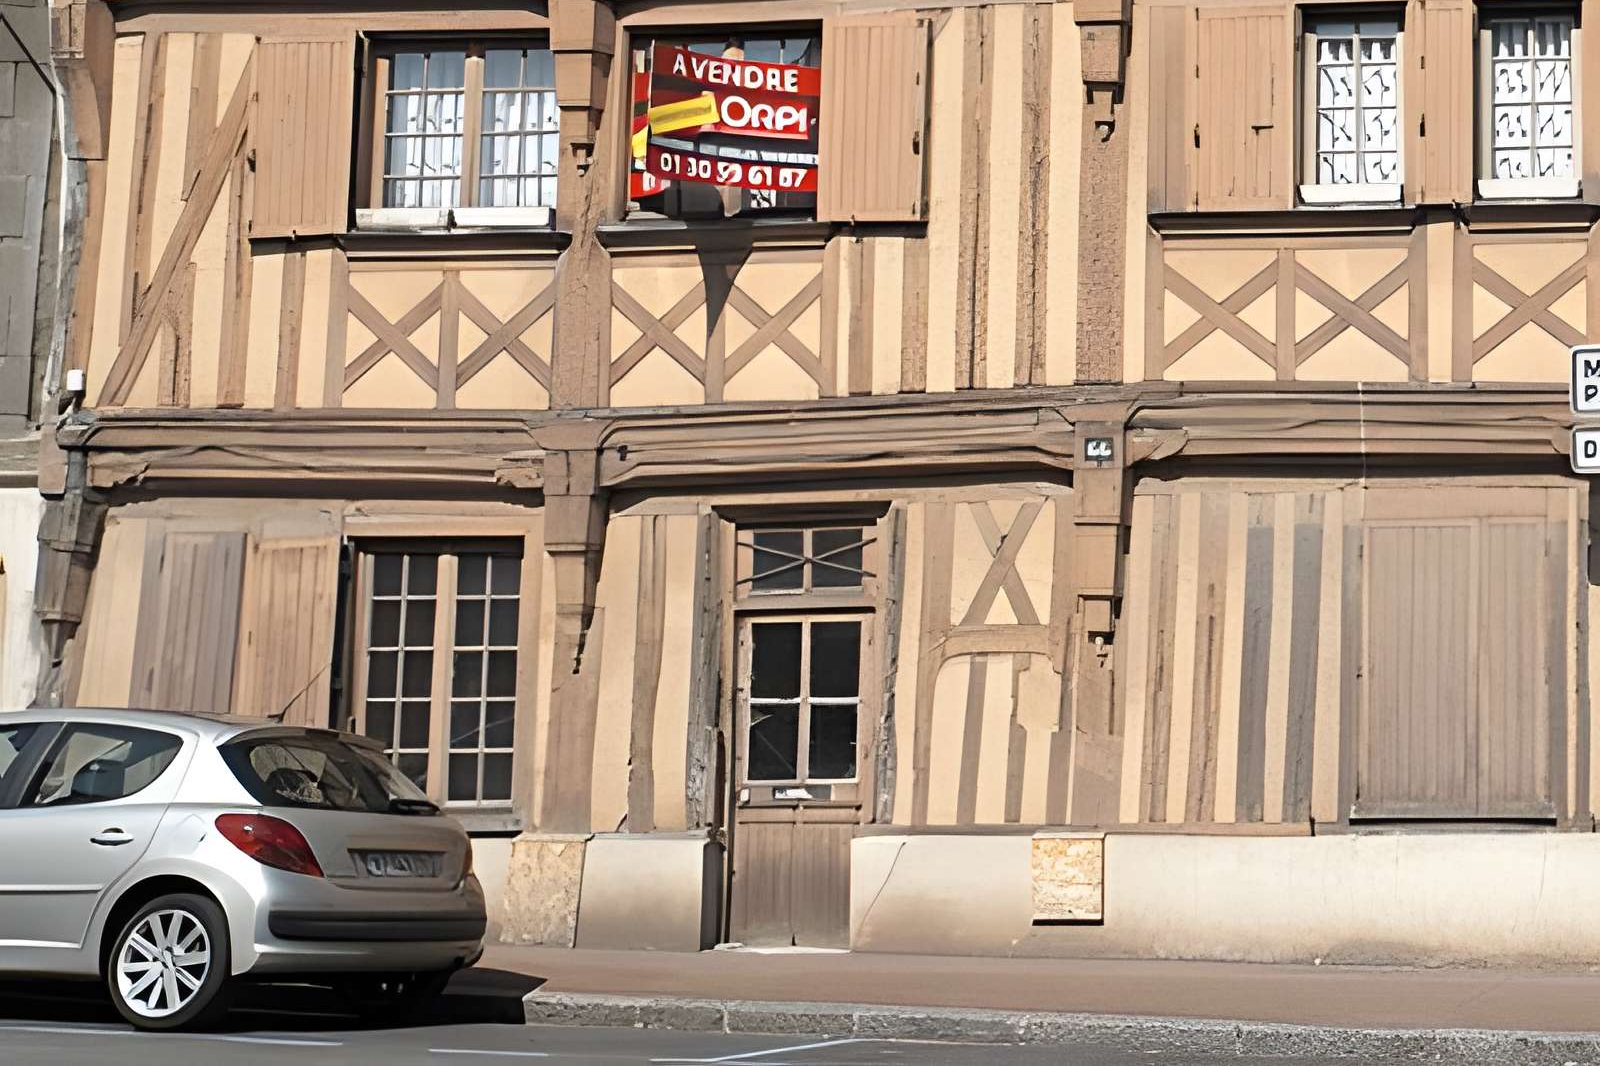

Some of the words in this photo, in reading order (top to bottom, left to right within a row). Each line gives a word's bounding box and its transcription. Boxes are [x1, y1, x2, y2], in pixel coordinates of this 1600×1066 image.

[673, 53, 687, 77] A
[690, 57, 799, 93] VENDRE
[660, 152, 681, 175] 01
